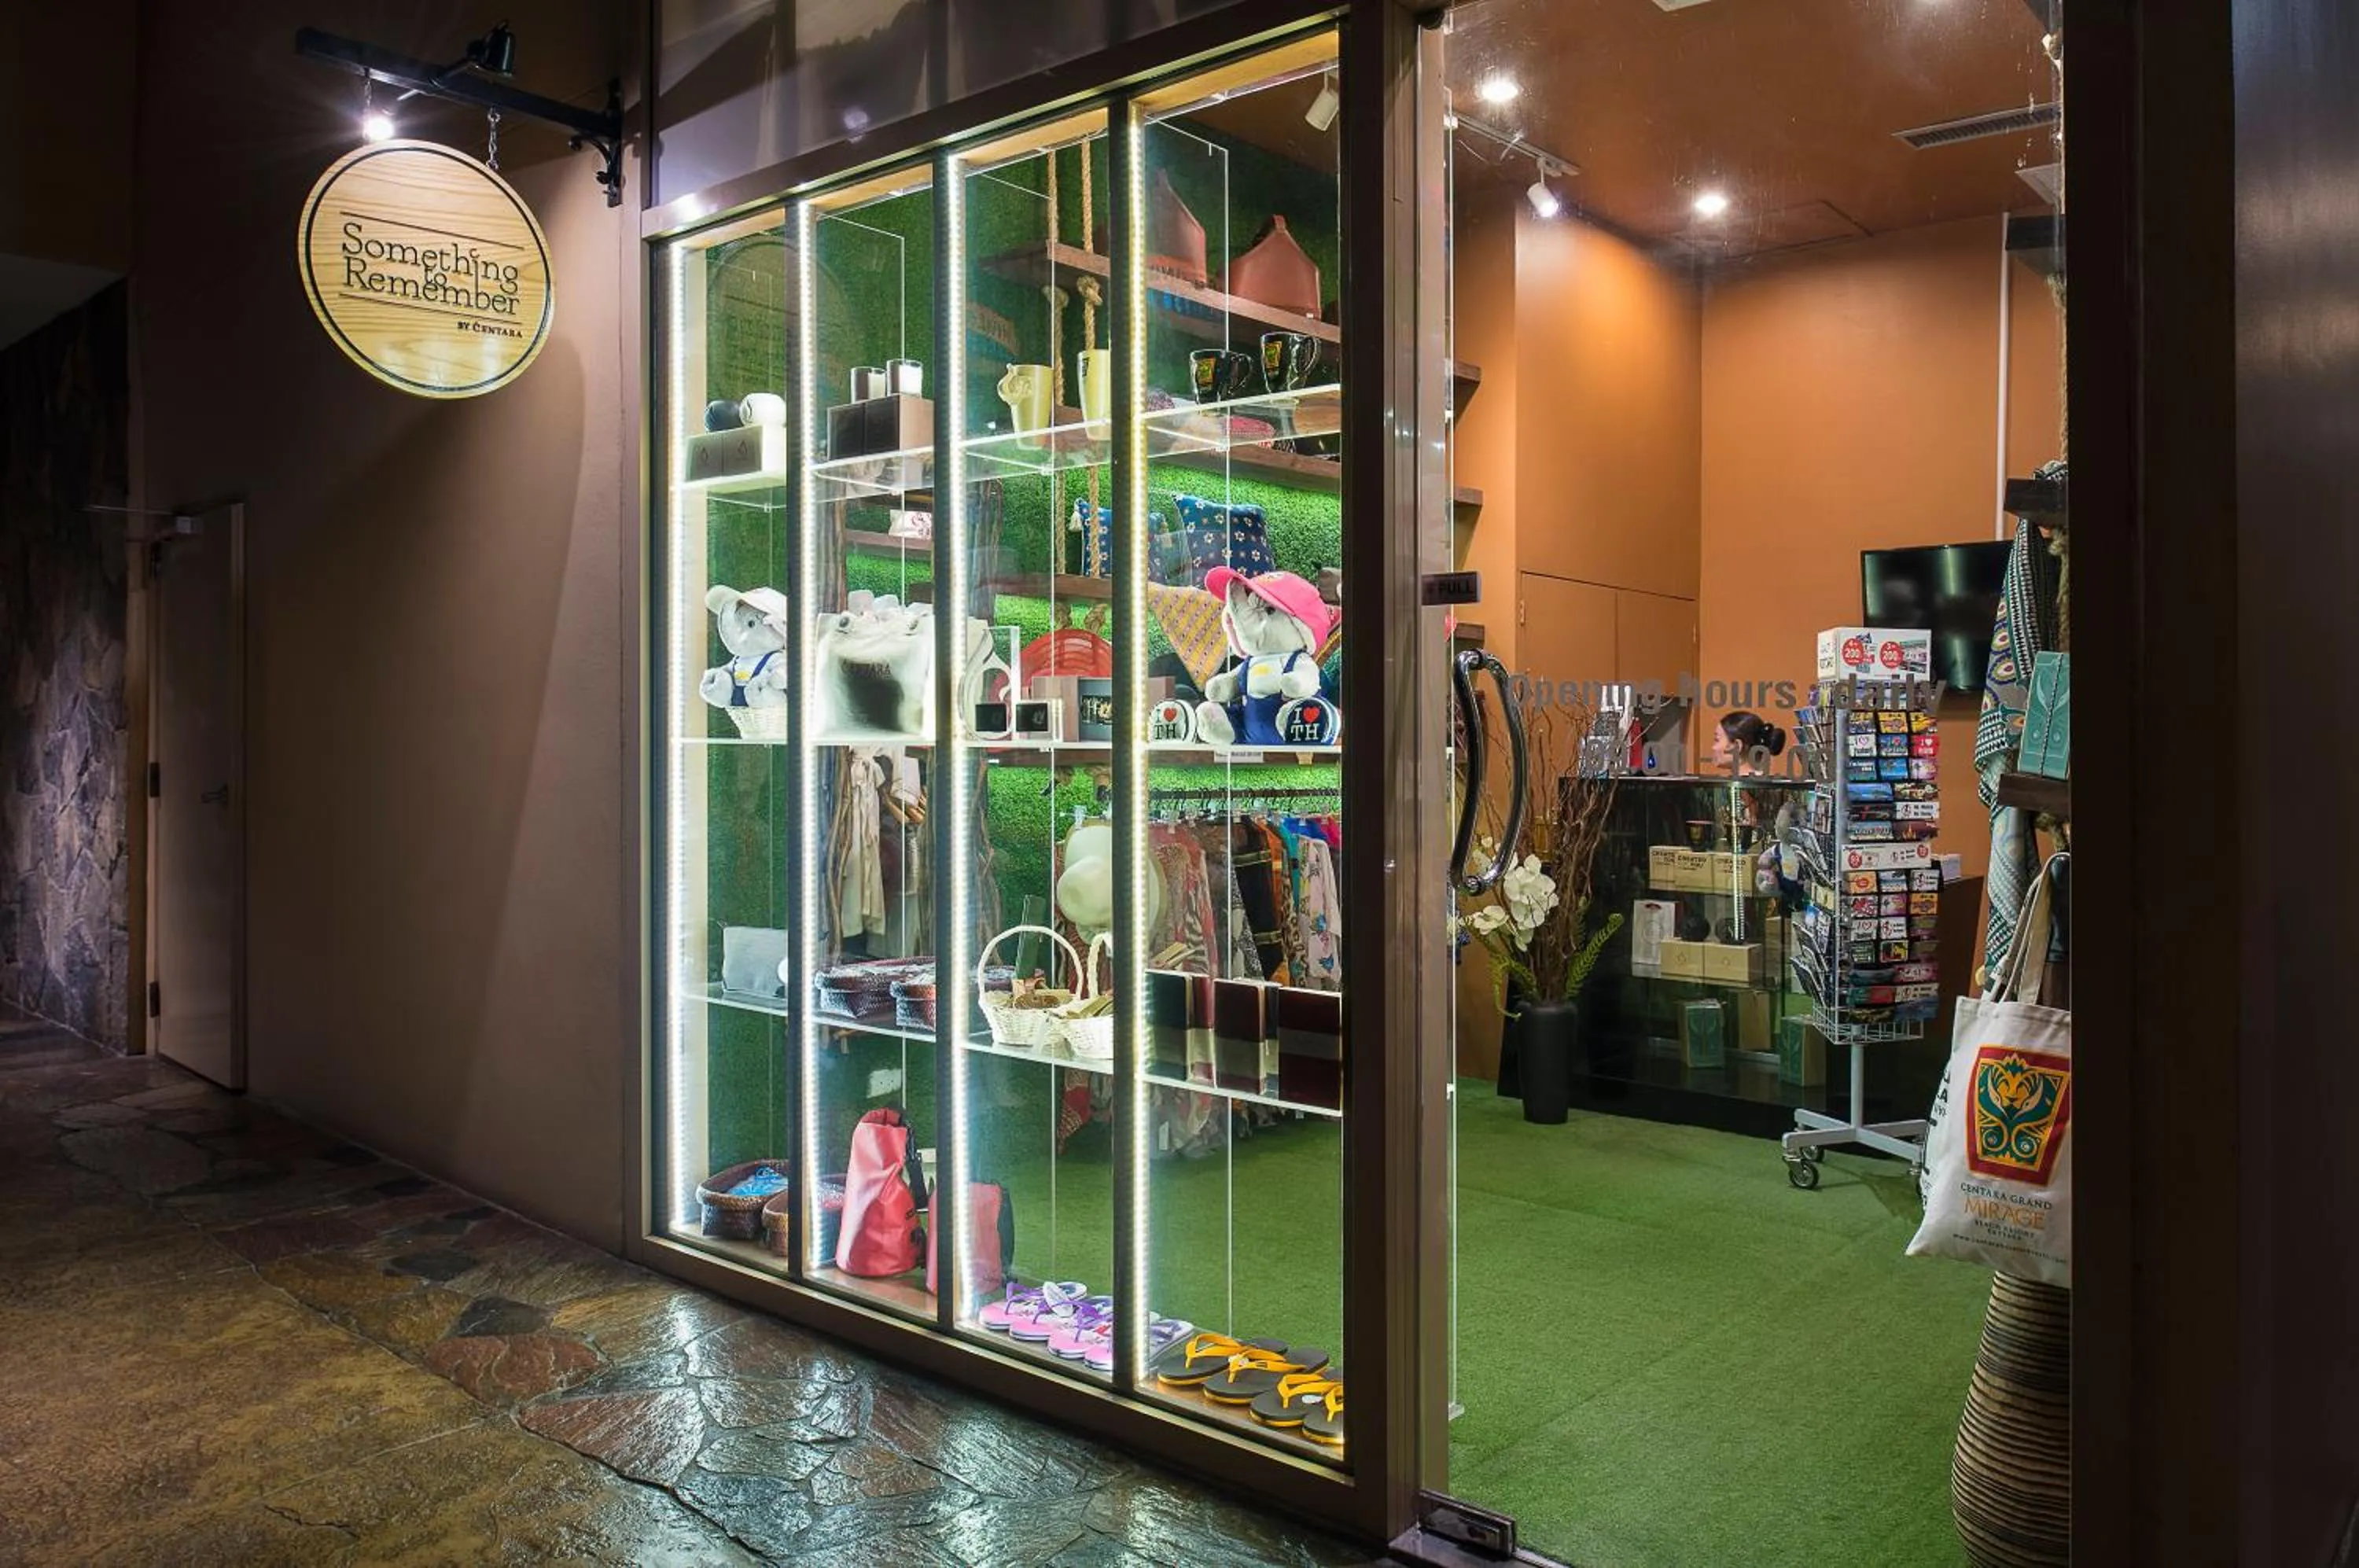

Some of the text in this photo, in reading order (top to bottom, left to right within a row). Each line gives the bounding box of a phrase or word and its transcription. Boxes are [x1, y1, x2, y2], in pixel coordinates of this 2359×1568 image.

[341, 221, 519, 295] Something
[343, 256, 521, 316] Remember
[423, 265, 448, 287] to
[457, 320, 472, 331] BY
[1507, 670, 1947, 715] Opening hours daily
[1155, 709, 1161, 723] I
[1294, 707, 1301, 723] I
[1154, 722, 1177, 740] TH
[1290, 723, 1319, 742] TH
[1960, 1182, 2053, 1211] CENTARA GRAND
[1963, 1196, 2045, 1230] MIRAGE
